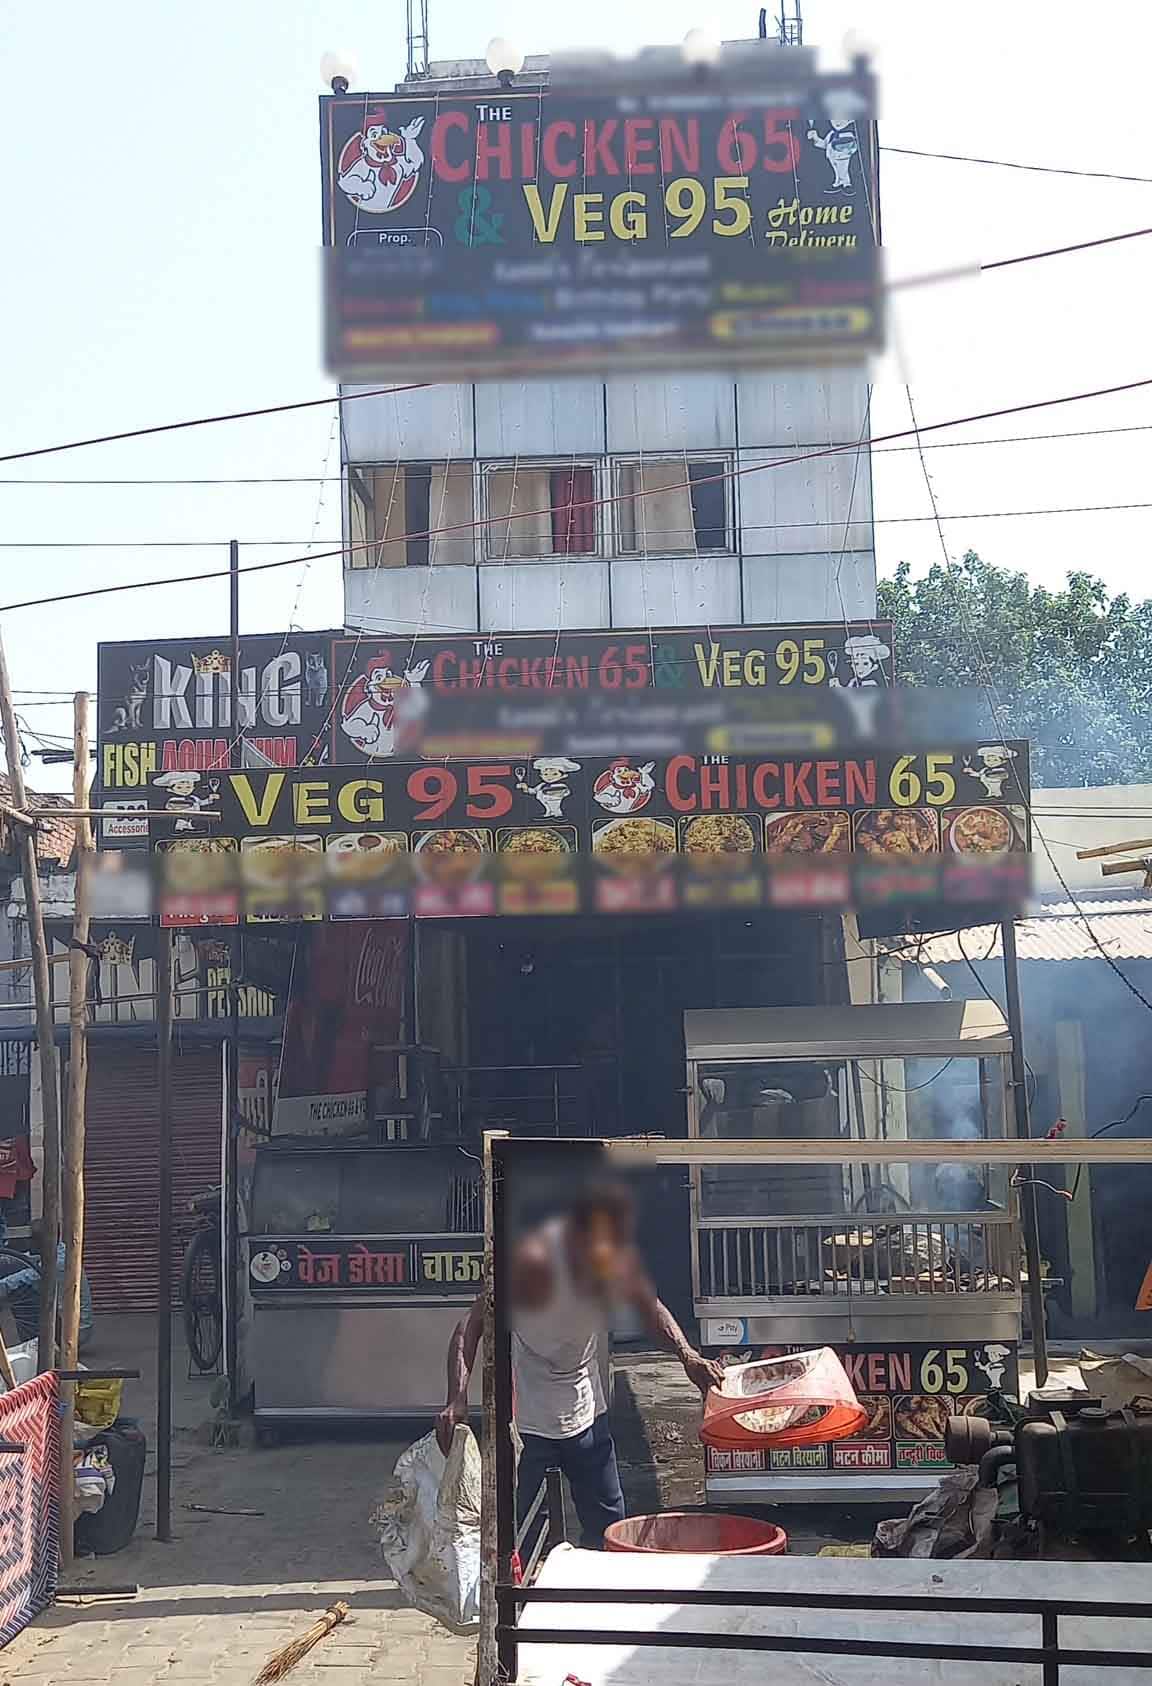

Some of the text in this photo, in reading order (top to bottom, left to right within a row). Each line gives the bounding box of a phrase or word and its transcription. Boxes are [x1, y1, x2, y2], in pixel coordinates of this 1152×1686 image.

[476, 104, 513, 122] THE
[430, 107, 800, 181] CHICKEN 65
[455, 176, 752, 246] & VEG 95
[768, 197, 853, 228] Home
[379, 233, 412, 247] Prop.
[432, 650, 590, 691] CHICKEN
[600, 645, 647, 690] 65
[694, 642, 765, 688] VEG
[775, 639, 826, 687] 95
[473, 641, 504, 656] THE
[103, 742, 156, 787] FISH
[703, 754, 729, 766] THE
[228, 765, 513, 827] VEG 95
[665, 754, 956, 811] CHICKEN 65
[920, 1349, 968, 1393] 65
[835, 1449, 859, 1465] मटन
